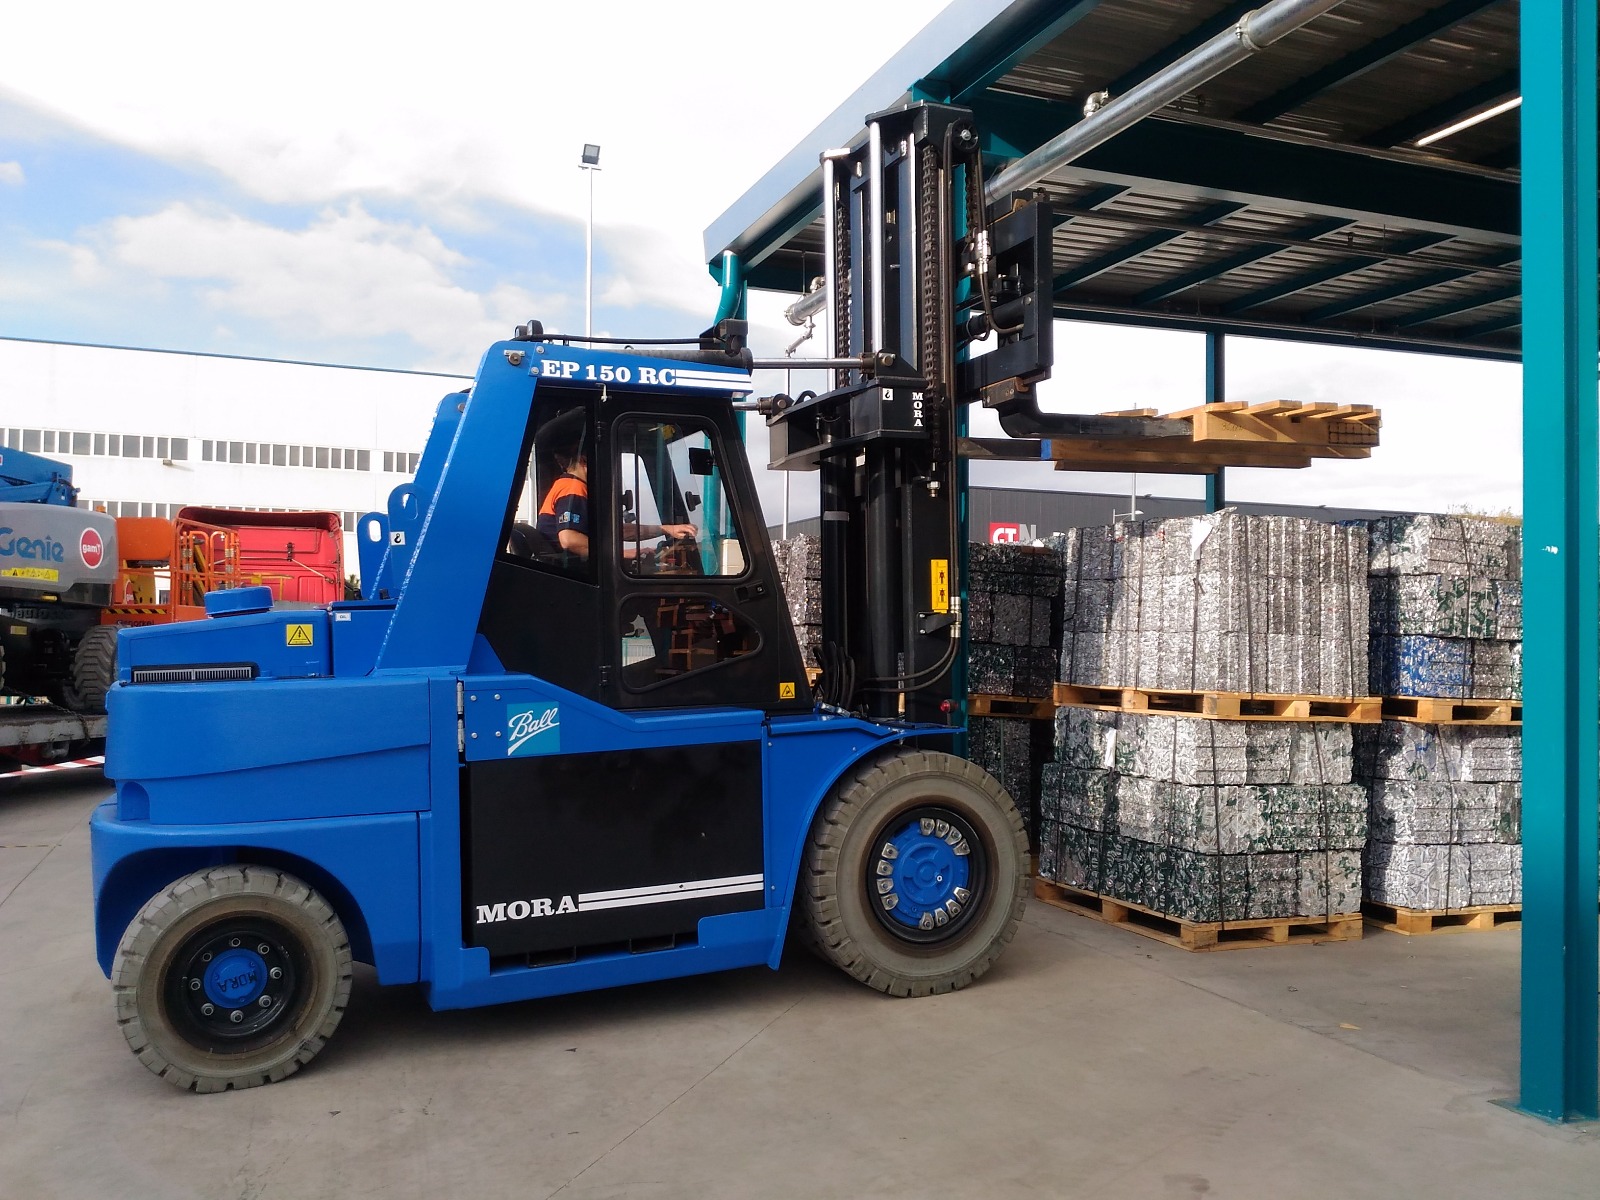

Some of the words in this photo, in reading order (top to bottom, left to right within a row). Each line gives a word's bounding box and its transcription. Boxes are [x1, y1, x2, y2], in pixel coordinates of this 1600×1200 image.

[541, 359, 580, 379] EP
[585, 364, 632, 383] 150
[638, 366, 677, 386] RC
[911, 391, 924, 427] MORA
[0, 526, 64, 563] Genie
[508, 707, 560, 752] Ball
[475, 895, 579, 924] MORA
[216, 969, 258, 993] MORA
